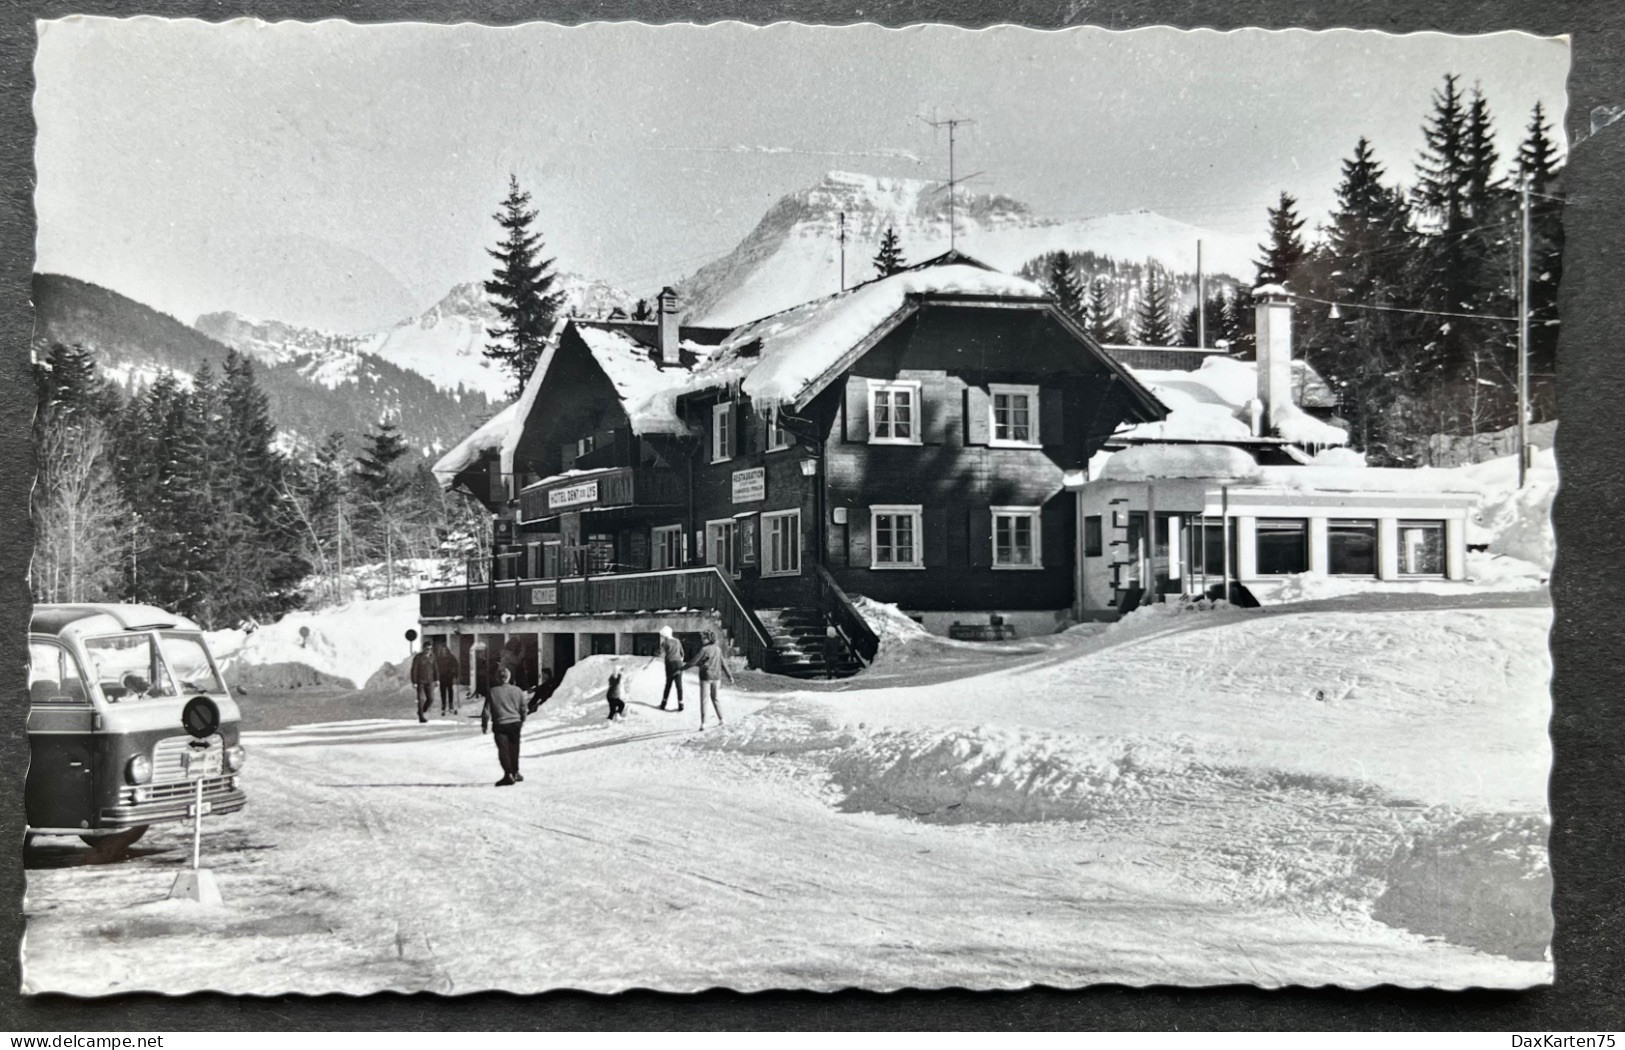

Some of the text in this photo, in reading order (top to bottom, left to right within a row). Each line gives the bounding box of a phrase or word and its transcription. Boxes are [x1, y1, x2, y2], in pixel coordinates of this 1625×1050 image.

[733, 470, 764, 482] RESTAURATION
[550, 491, 566, 504] HOTEL
[567, 489, 579, 502] DENT
[587, 485, 596, 498] LYS
